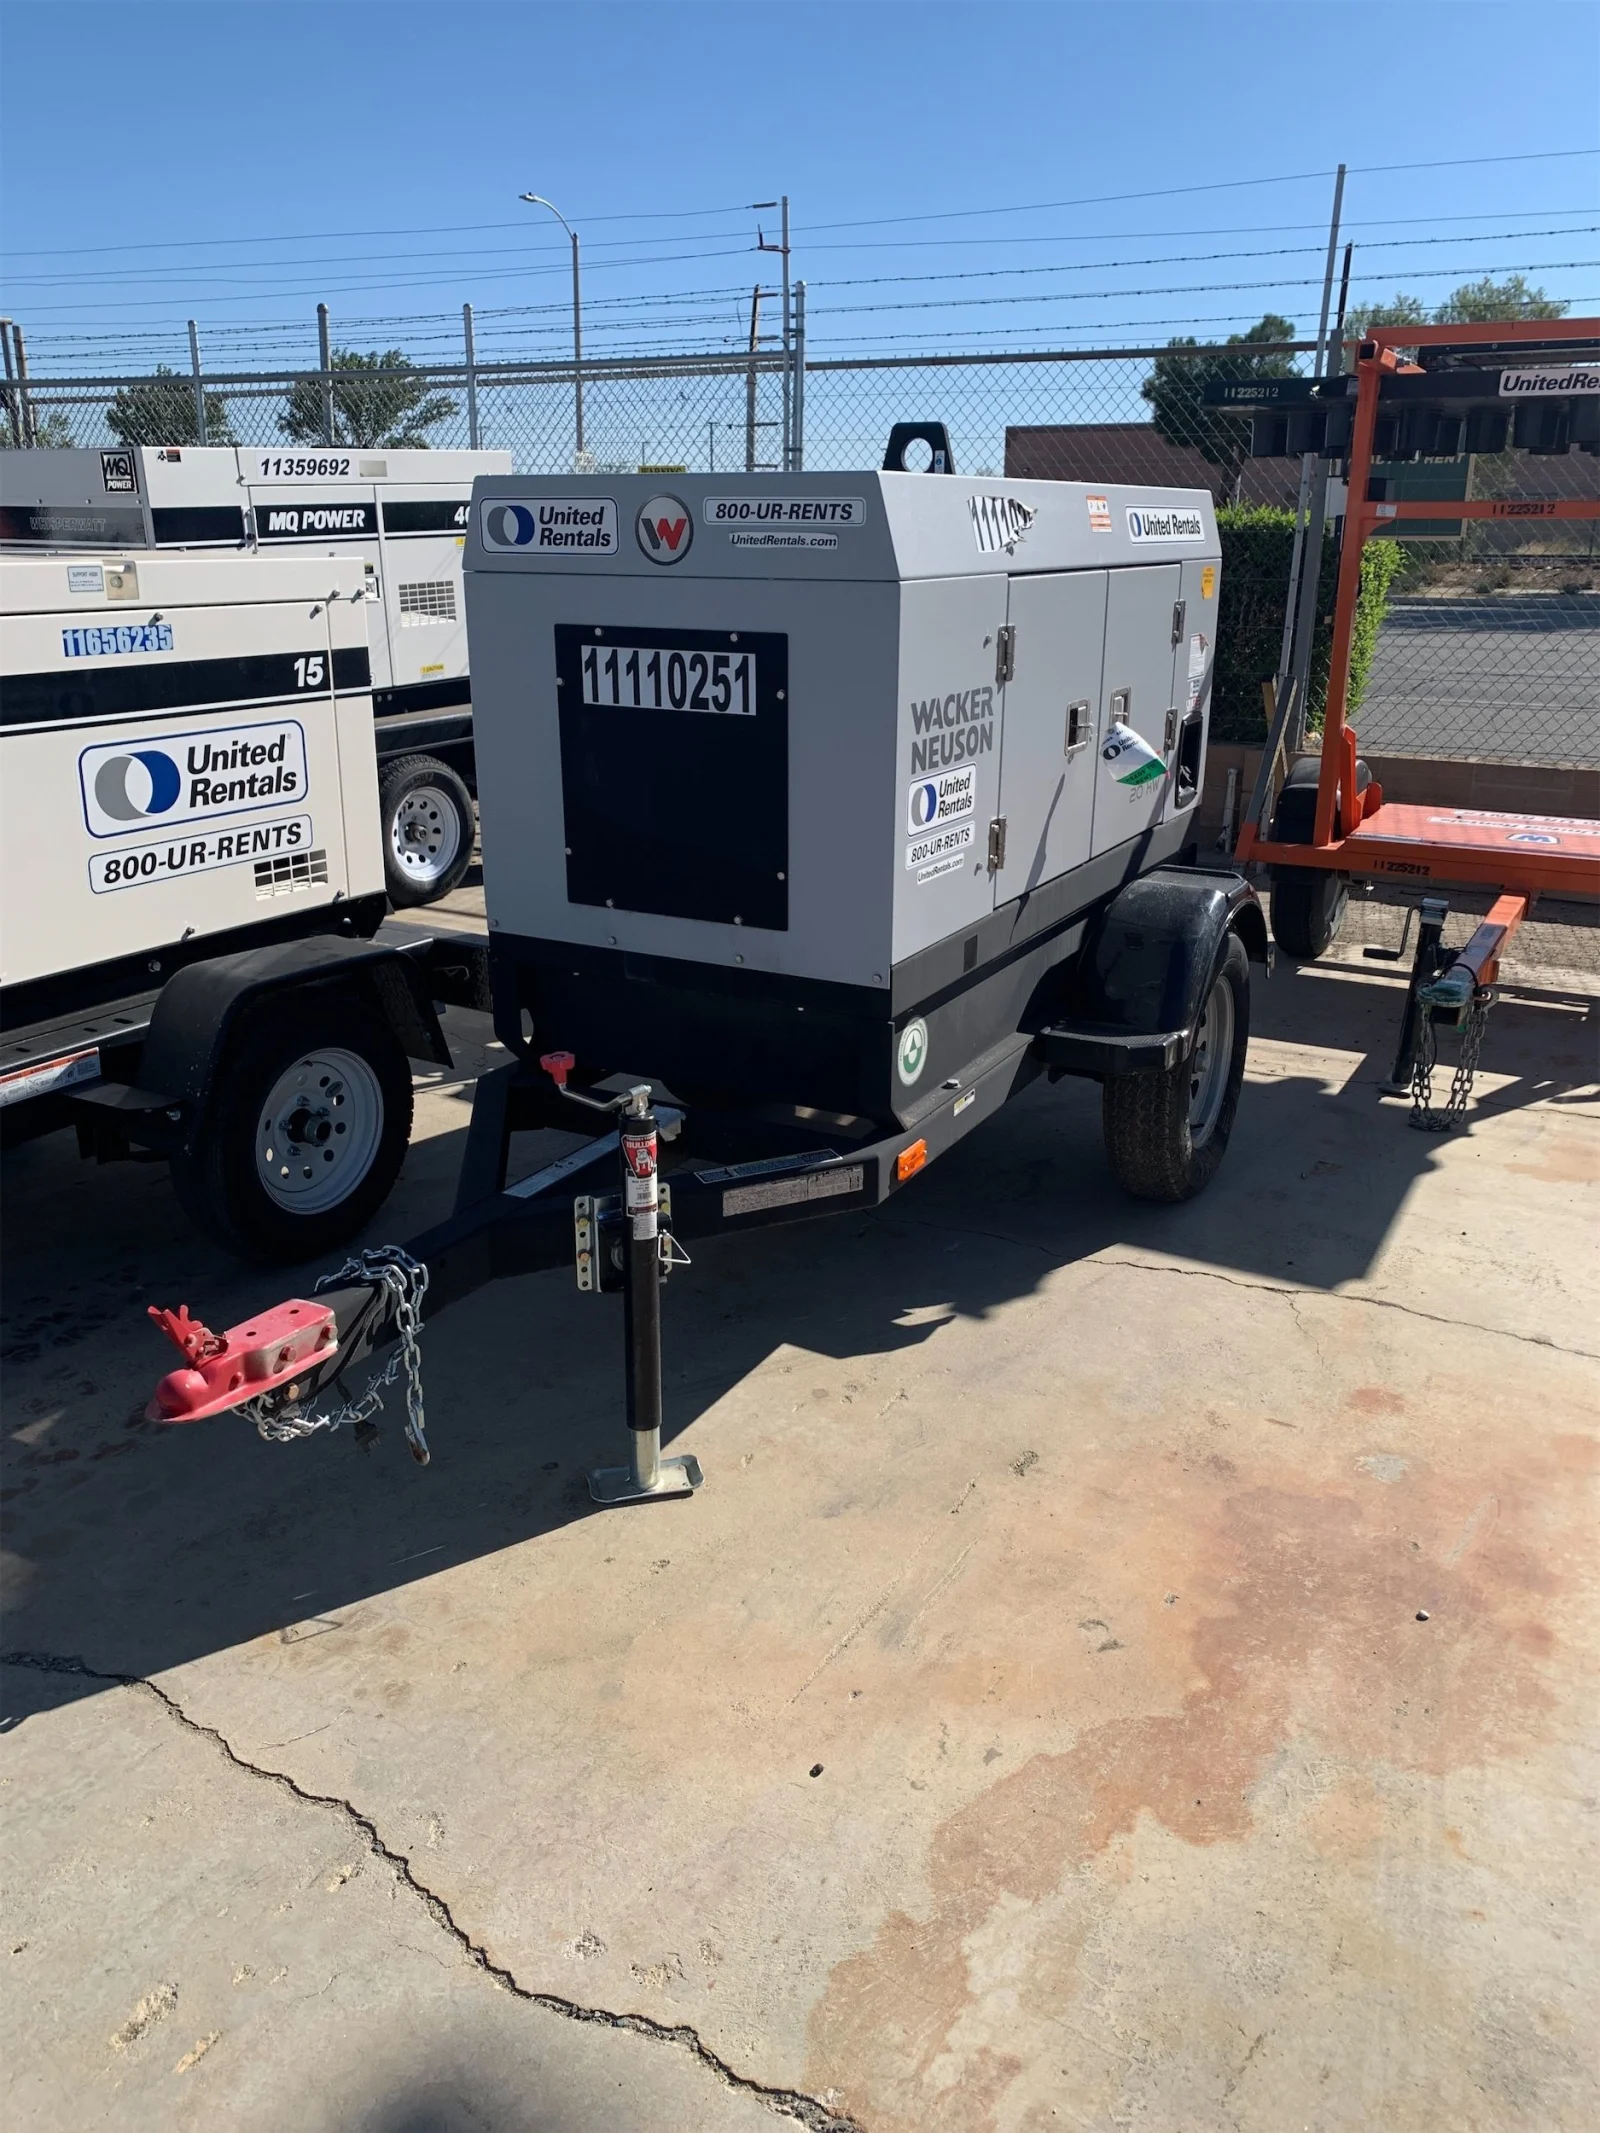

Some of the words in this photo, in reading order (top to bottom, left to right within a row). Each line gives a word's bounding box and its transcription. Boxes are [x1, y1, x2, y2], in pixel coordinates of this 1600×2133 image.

[1224, 387, 1279, 398] 11225212
[1503, 373, 1600, 392] UnitedRe
[102, 455, 132, 476] MQ
[260, 458, 350, 476] 11359692
[107, 480, 132, 490] POWER
[538, 506, 604, 525] United
[715, 502, 853, 520] 800-UR-RENTS
[1492, 503, 1556, 515] 11225212
[29, 517, 106, 532] WHISPERWATT
[268, 511, 299, 533] MQ
[302, 509, 365, 530] POWER
[1142, 513, 1172, 536] United
[1171, 513, 1201, 535] Rentals
[538, 527, 612, 547] Rentals
[731, 534, 837, 548] UnitedRentals.com
[62, 626, 173, 656] 11656235
[293, 656, 324, 687] 15
[584, 647, 750, 713] 11110251
[910, 686, 994, 735] WACKER
[187, 734, 286, 775] United
[911, 721, 994, 775] NEUSON
[189, 766, 297, 808] Rentals
[939, 772, 972, 798] United
[937, 792, 973, 819] Rentals
[103, 822, 302, 884] 800-UR-RENTS
[911, 827, 970, 863] 800-UR-RENTS
[917, 858, 964, 882] UnitedRentals.com
[1373, 859, 1431, 876] 11225212
